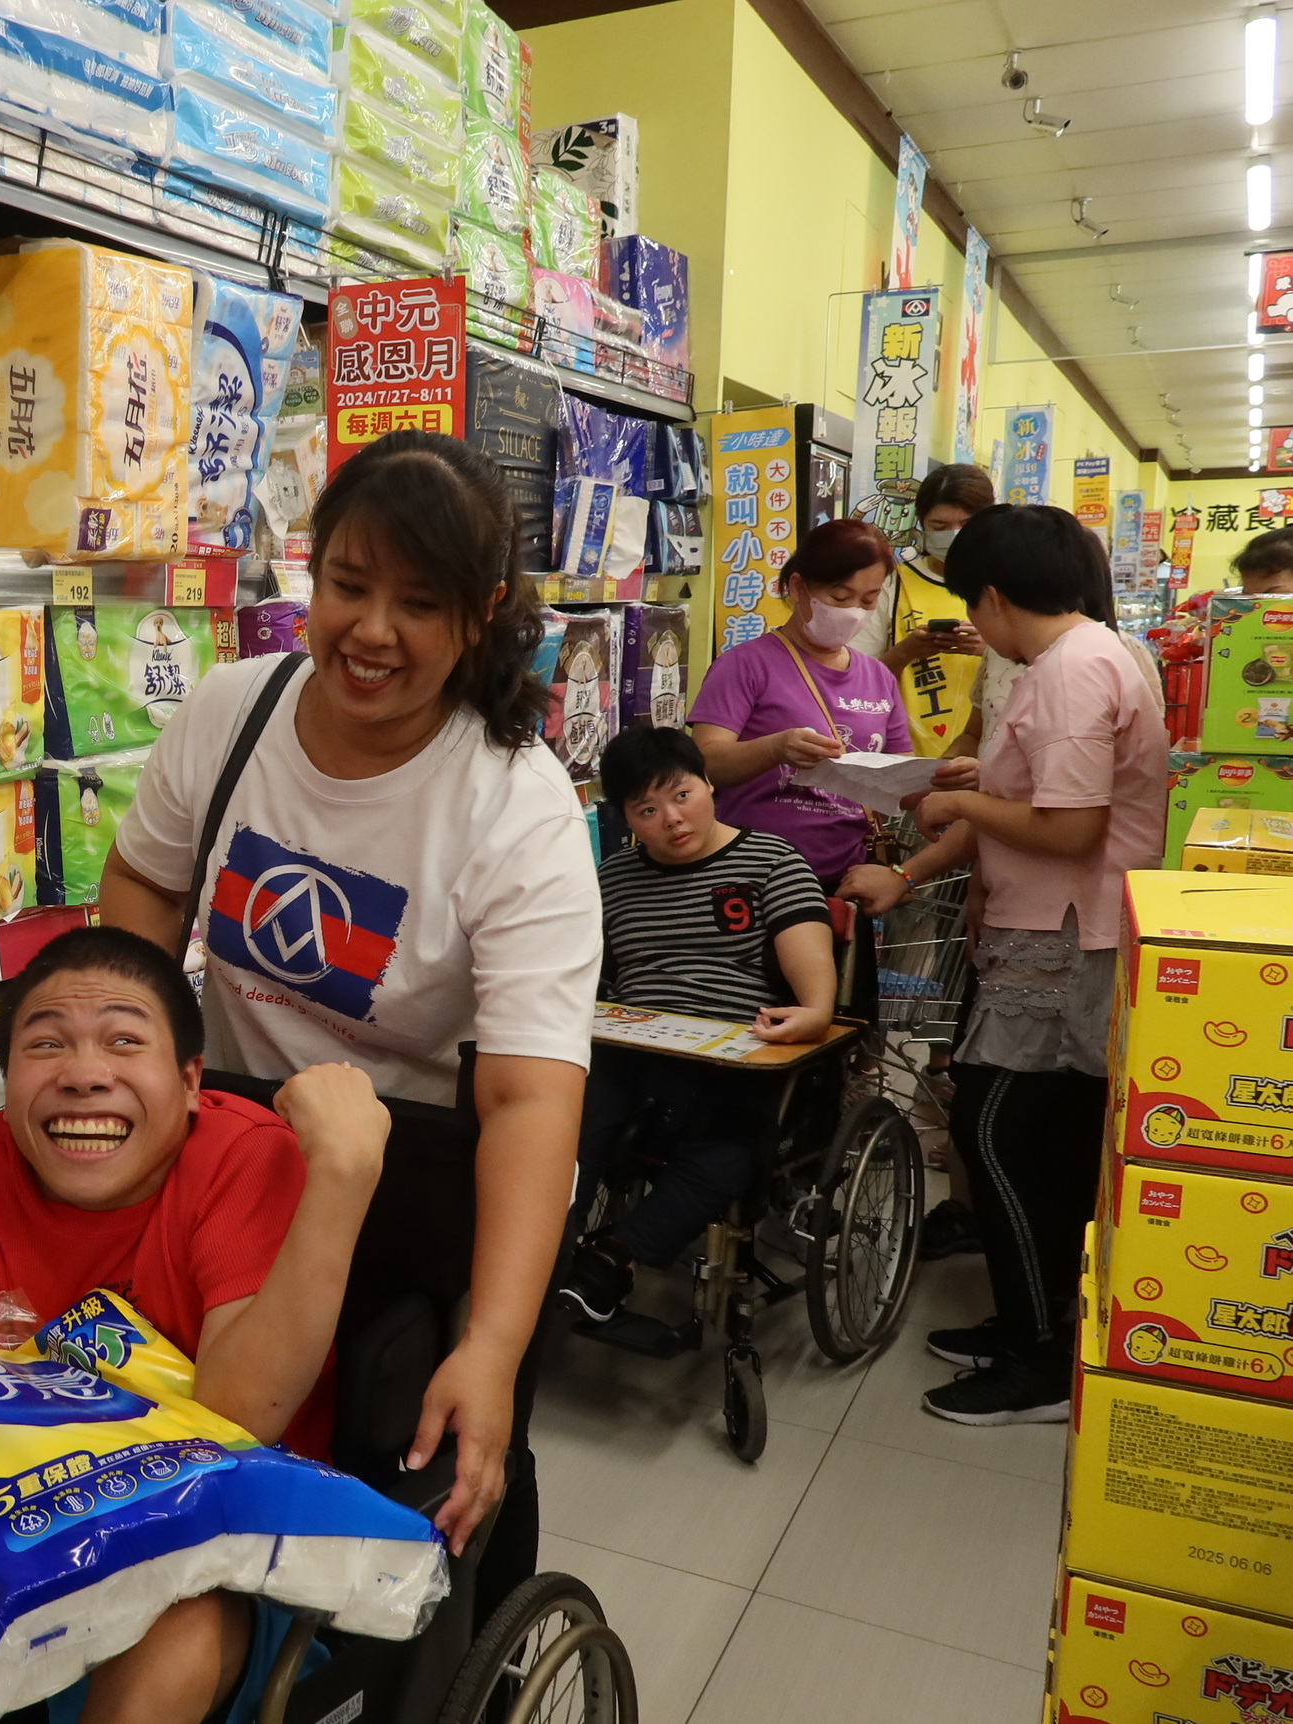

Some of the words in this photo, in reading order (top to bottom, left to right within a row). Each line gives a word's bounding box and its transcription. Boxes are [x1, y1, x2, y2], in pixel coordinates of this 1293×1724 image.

[357, 287, 440, 334] 中元
[334, 336, 457, 386] 感恩月
[8, 364, 36, 459] 五月花
[124, 352, 149, 472] 五月花
[337, 387, 452, 406] 2024/7/27~8/11
[863, 322, 929, 481] 新冰報到
[189, 405, 205, 455] Kleenex
[498, 426, 542, 463] SILLACE
[731, 428, 783, 450] 小時達
[721, 462, 765, 654] 就叫小時達
[70, 585, 89, 601] 192
[186, 587, 203, 602] 219
[152, 648, 173, 662] Kleenex
[144, 665, 186, 697] 舒潔
[723, 898, 750, 932] 9
[1158, 975, 1198, 986] カンパニー
[1165, 966, 1193, 976] おやつ
[332, 1022, 356, 1042] life
[1141, 1198, 1180, 1209] カンパニー
[1147, 1189, 1175, 1199] おやつ
[63, 1296, 105, 1332] 升級
[1213, 1304, 1291, 1335] 星太郎
[1168, 1346, 1277, 1376] 超寬條餅雞汁6入
[1188, 1546, 1273, 1576] 2025.06.06
[1214, 1656, 1293, 1687] ベビース
